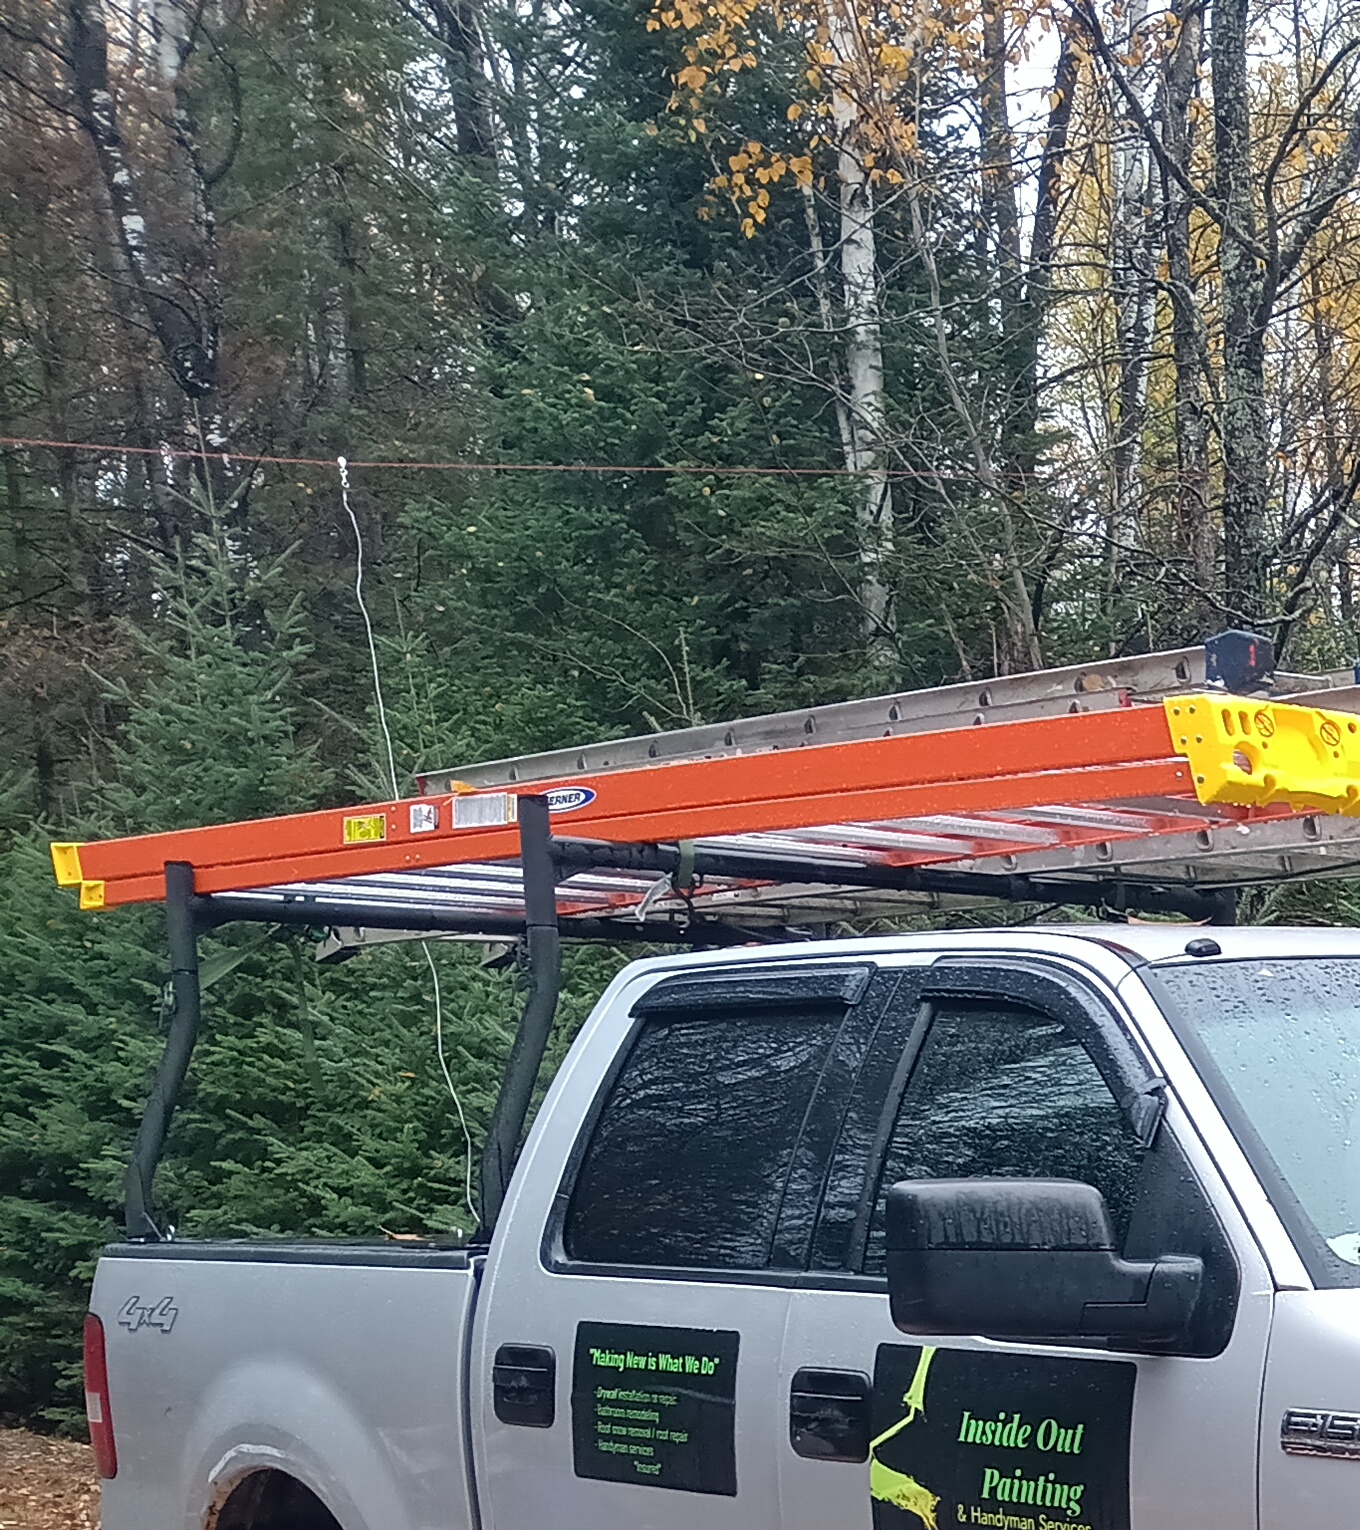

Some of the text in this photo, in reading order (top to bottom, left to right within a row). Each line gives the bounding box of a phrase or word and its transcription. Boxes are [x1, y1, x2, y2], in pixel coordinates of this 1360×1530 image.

[549, 793, 581, 805] ERNER
[117, 1295, 179, 1334] 4x4
[589, 1348, 720, 1375] "Making New is What We Do"
[959, 1411, 1085, 1455] Inside Out
[981, 1467, 1085, 1517] Painting
[957, 1504, 968, 1523] &
